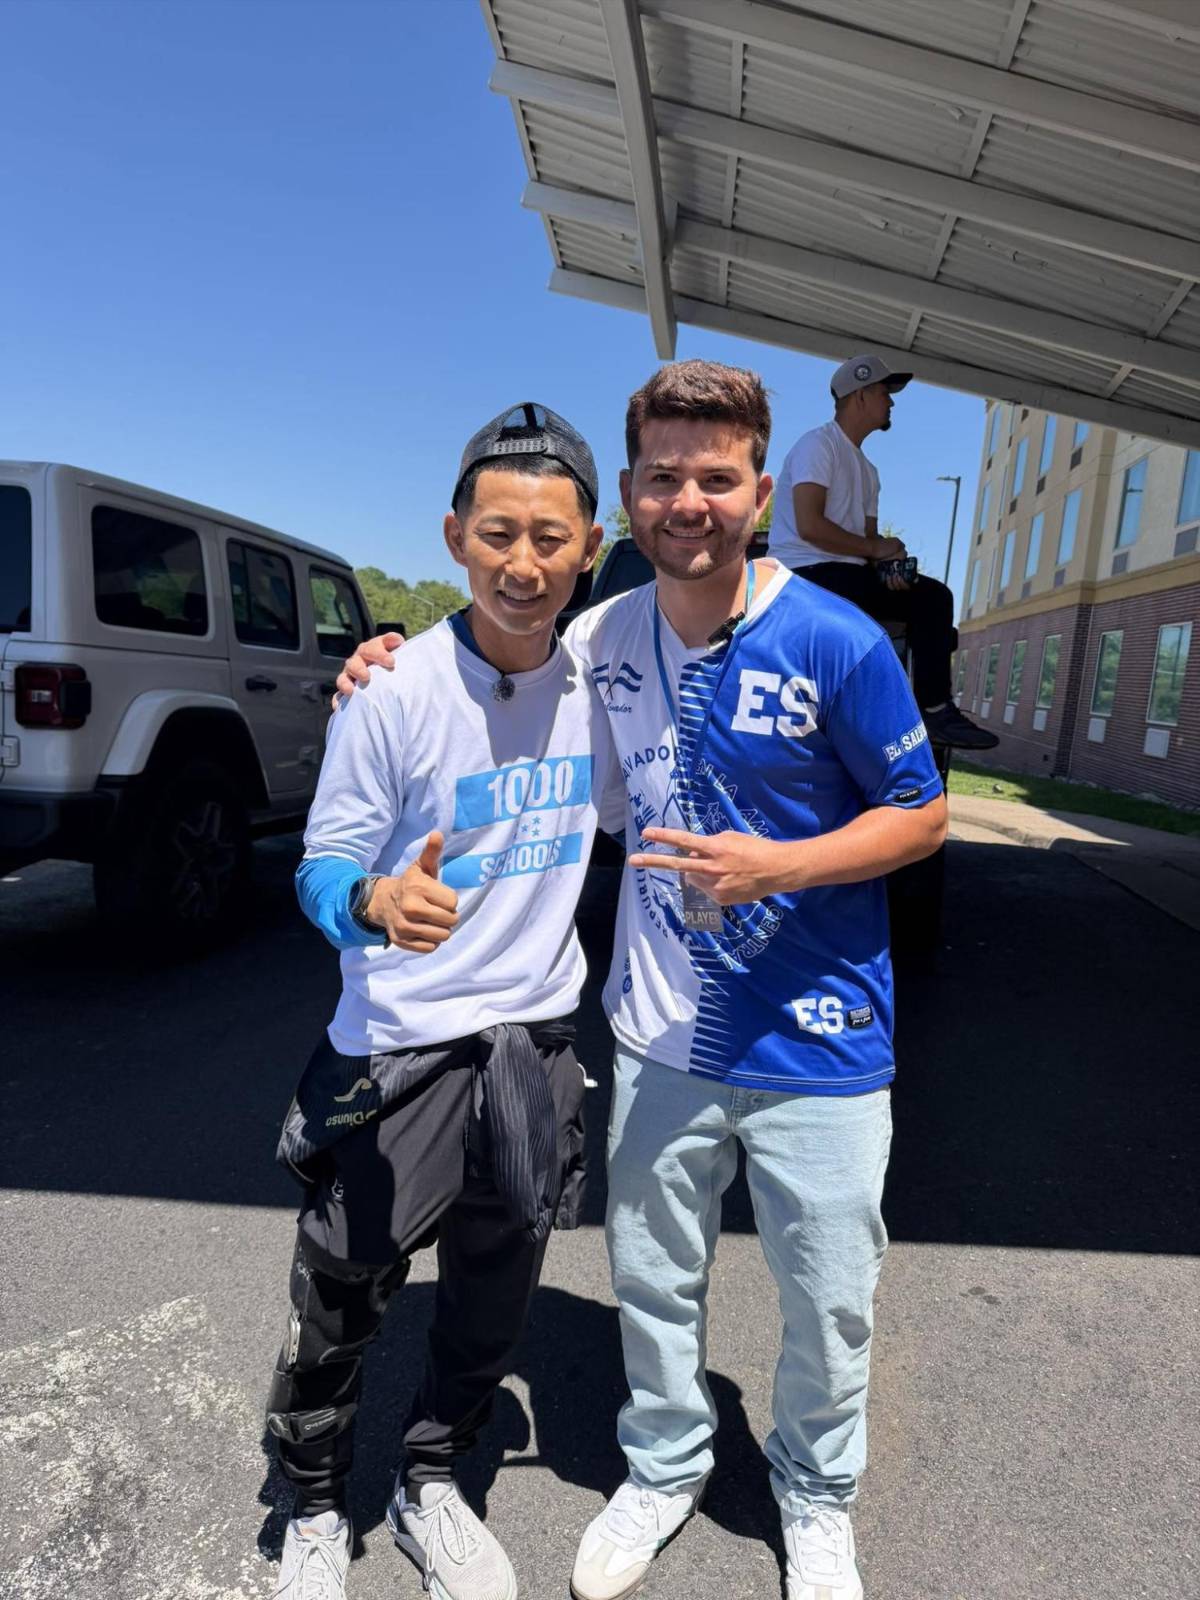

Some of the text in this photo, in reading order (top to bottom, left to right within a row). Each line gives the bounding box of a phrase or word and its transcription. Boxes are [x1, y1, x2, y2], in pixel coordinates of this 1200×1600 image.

[731, 669, 819, 737] ES
[884, 742, 904, 763] EL
[487, 760, 574, 818] 1000
[713, 773, 738, 802] LA
[718, 904, 784, 970] CENTRAL
[791, 996, 844, 1035] ES
